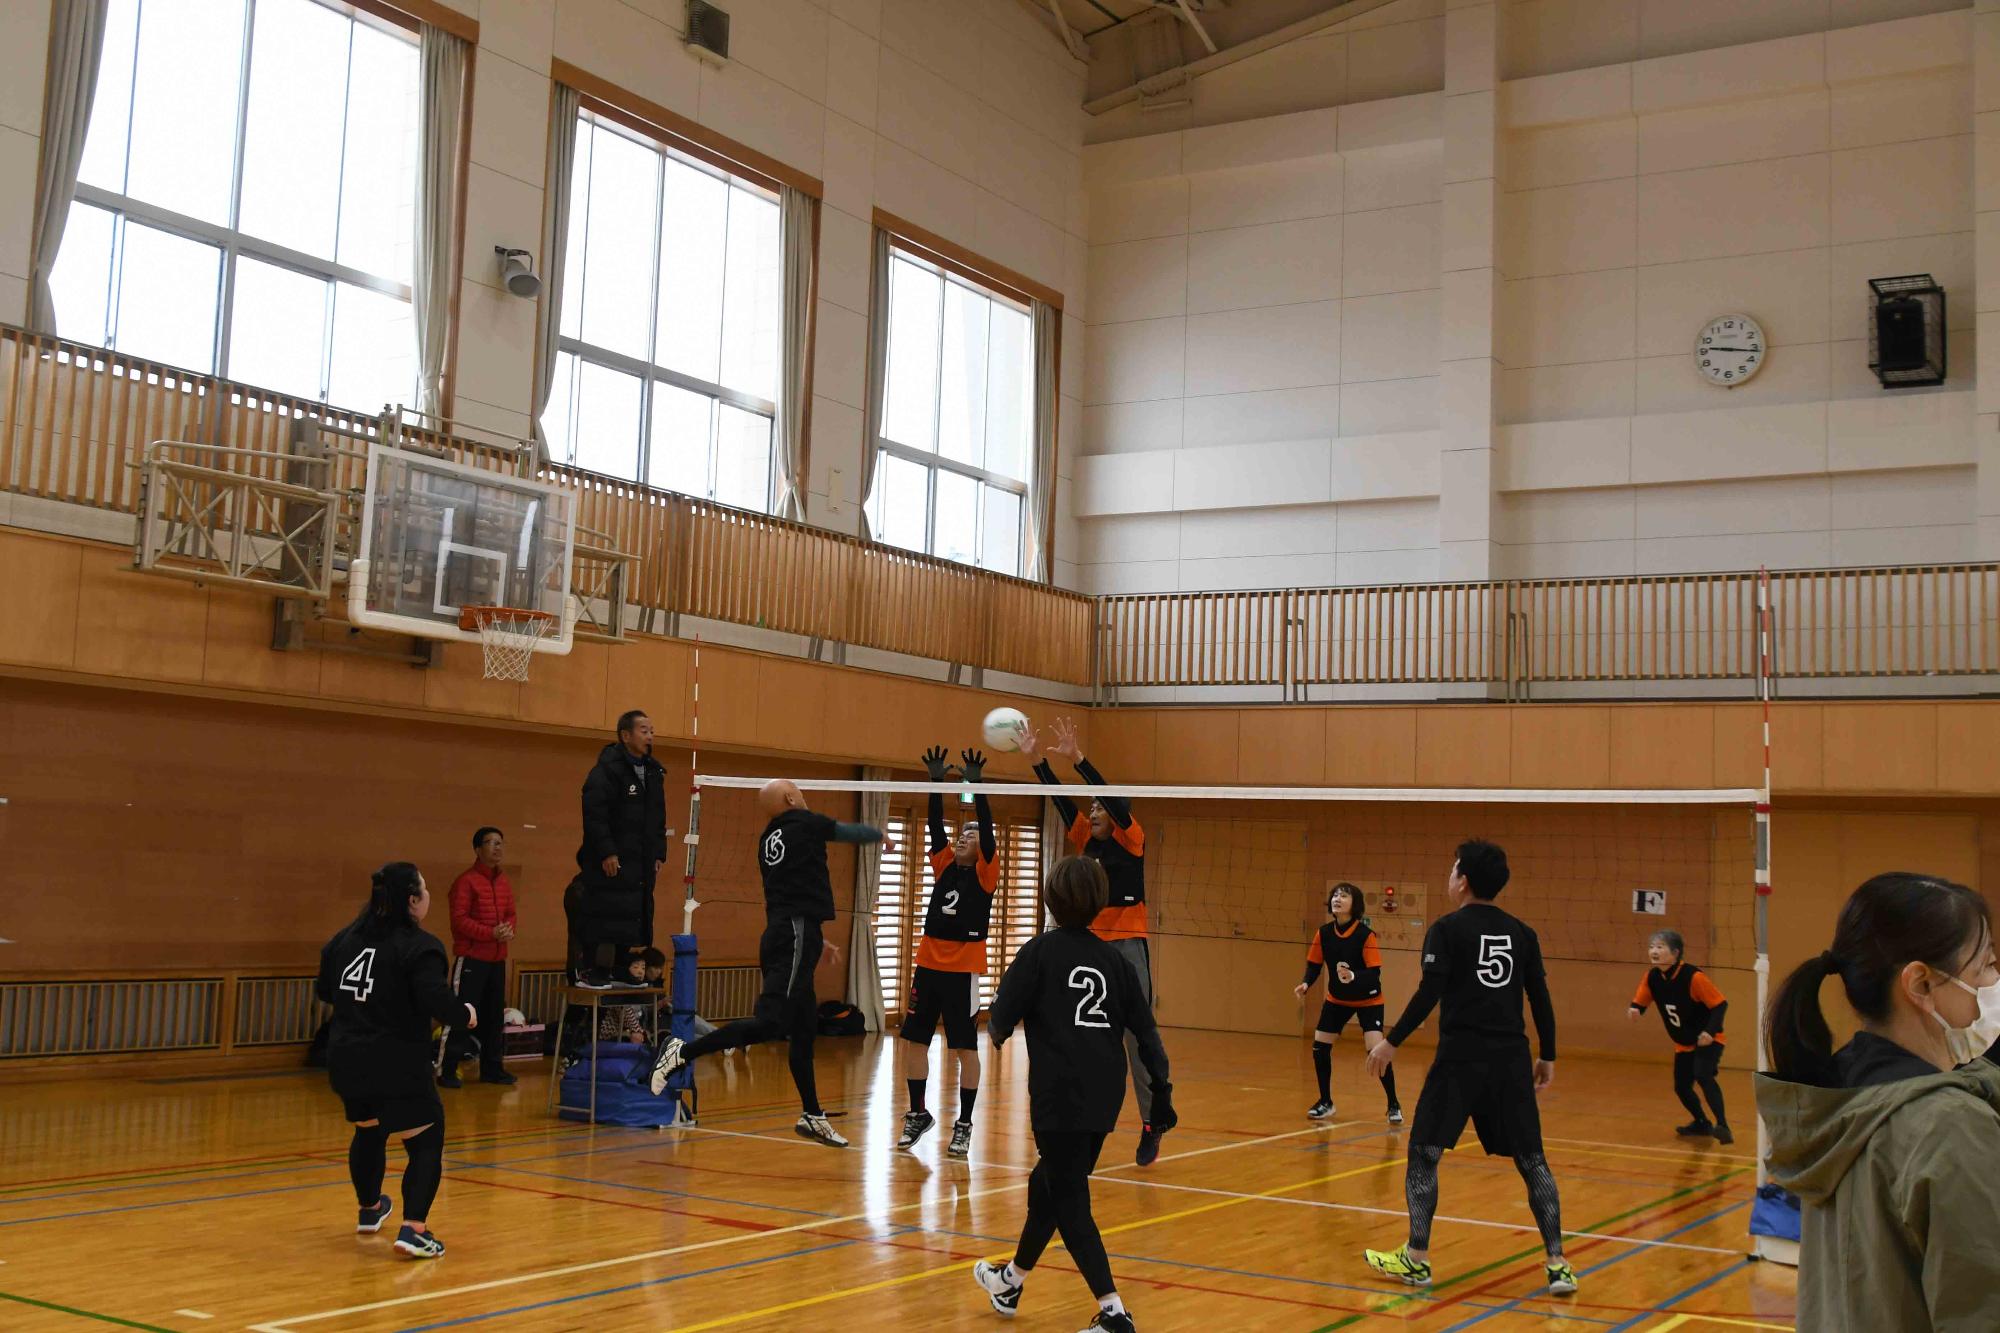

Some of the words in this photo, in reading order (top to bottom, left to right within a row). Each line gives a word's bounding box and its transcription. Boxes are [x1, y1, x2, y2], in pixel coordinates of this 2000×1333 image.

[1723, 320, 1734, 329] 12
[1711, 326, 1721, 334] 11
[1746, 331, 1755, 339] 2
[1699, 347, 1708, 356] 9
[1702, 359, 1711, 367] 8
[1712, 368, 1721, 376] 7
[1738, 365, 1747, 374] 5
[1723, 370, 1734, 379] 6
[764, 828, 786, 867] 6
[941, 889, 960, 916] 2
[1636, 890, 1664, 913] F
[1476, 934, 1514, 989] 5
[339, 947, 377, 1003] 4
[1068, 965, 1112, 1029] 2
[1665, 1003, 1681, 1029] 5
